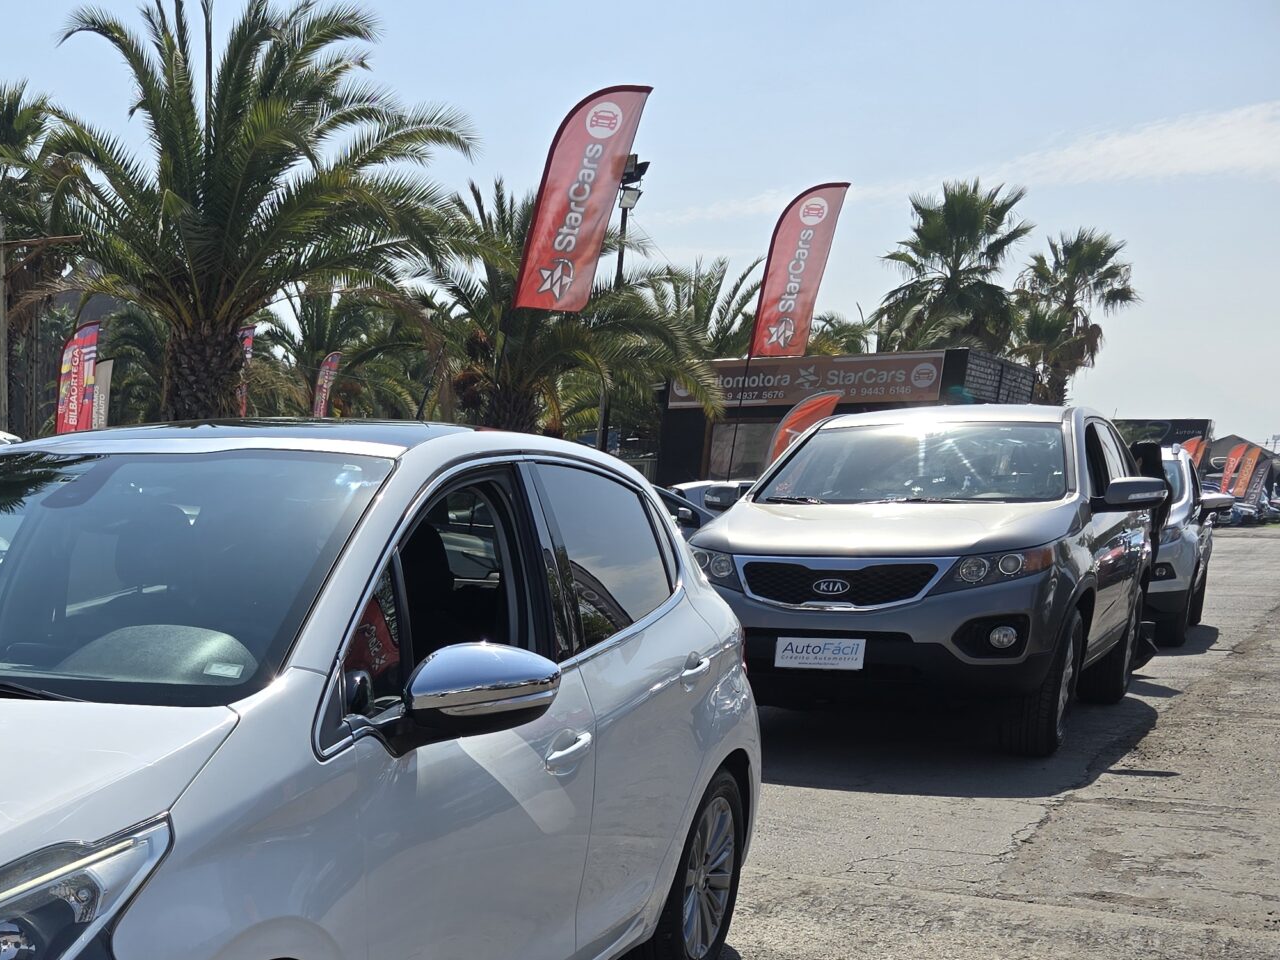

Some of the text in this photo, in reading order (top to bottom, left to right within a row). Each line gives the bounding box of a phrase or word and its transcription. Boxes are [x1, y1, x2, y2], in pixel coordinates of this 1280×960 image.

[554, 143, 603, 252] StarCars
[778, 229, 814, 312] StarCars
[826, 368, 906, 385] StarCars
[69, 348, 80, 426] BILBAORTEGA
[762, 391, 784, 399] 5676
[820, 582, 843, 591] KIA
[782, 642, 860, 656] AutoFácil
